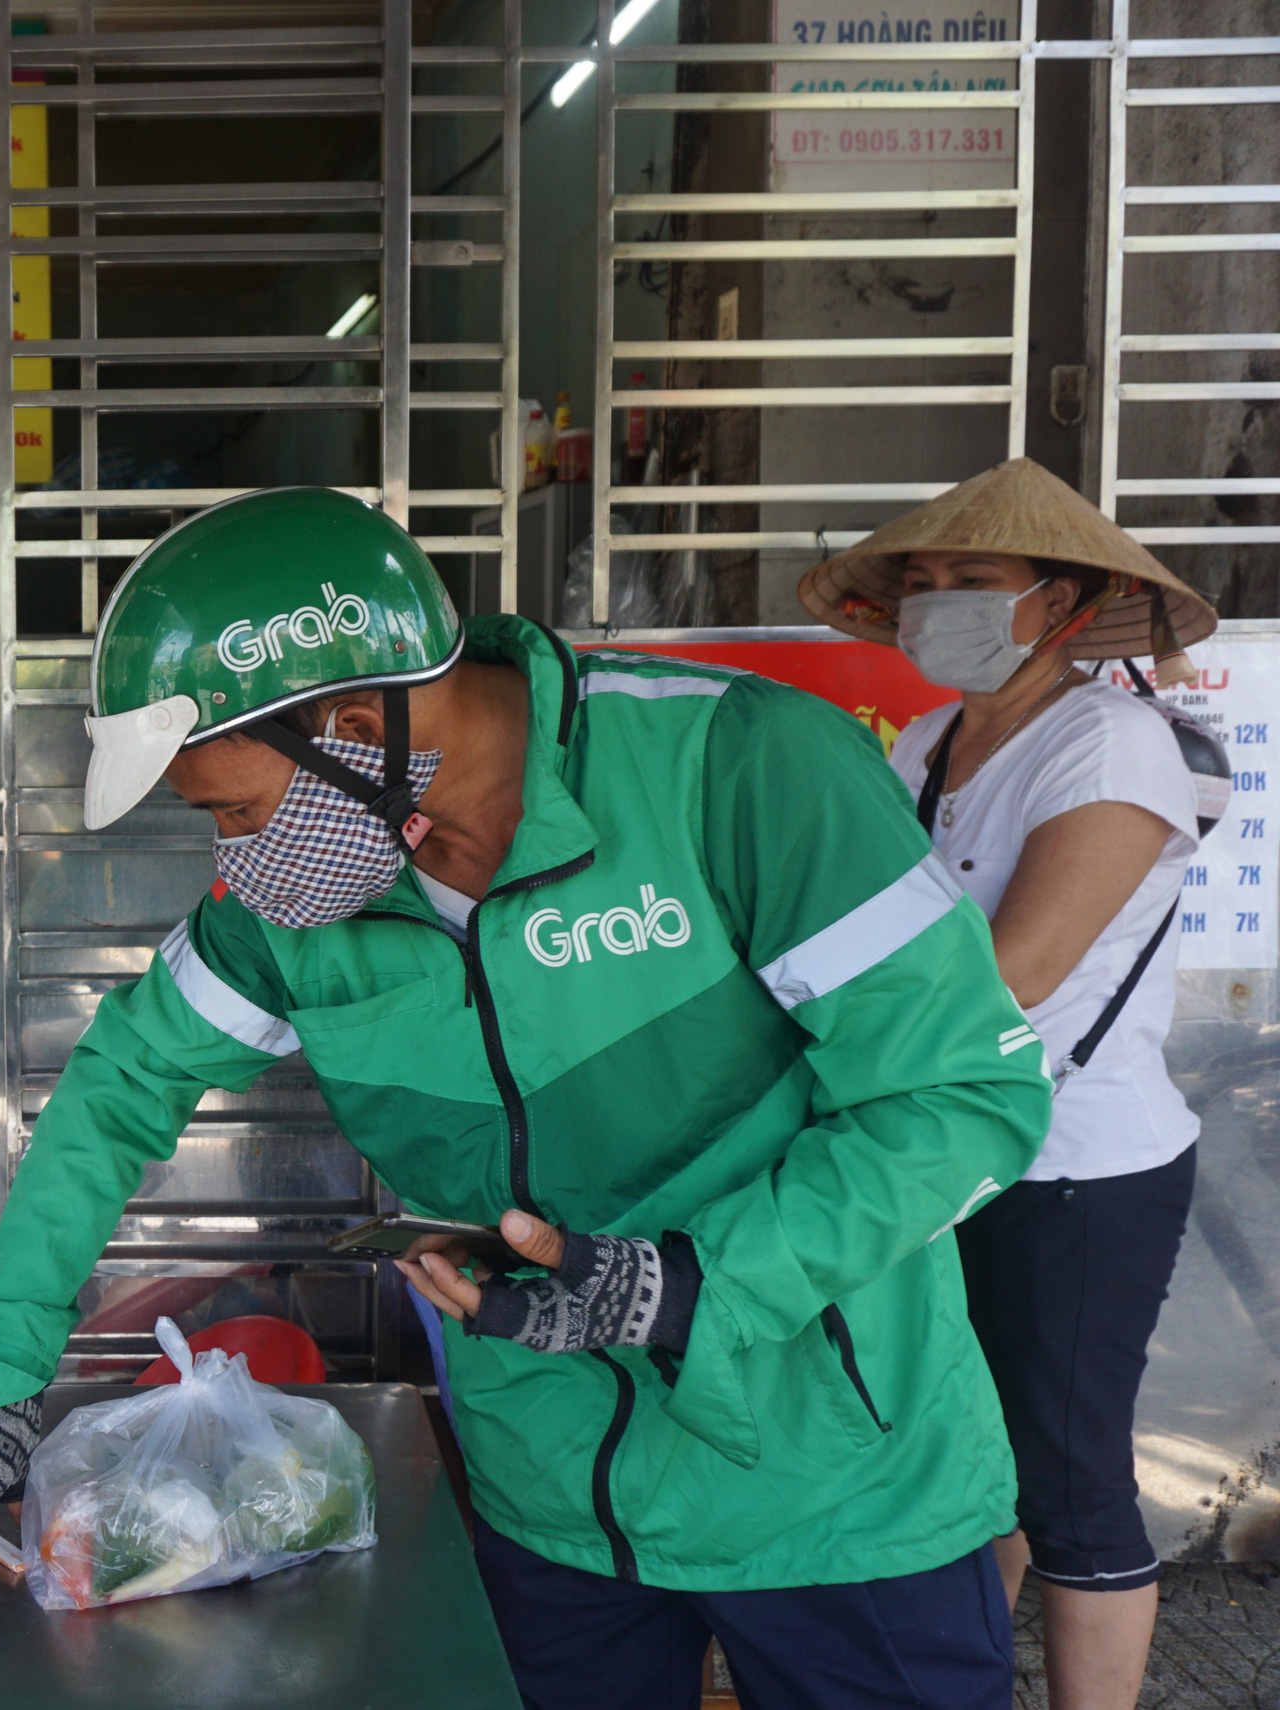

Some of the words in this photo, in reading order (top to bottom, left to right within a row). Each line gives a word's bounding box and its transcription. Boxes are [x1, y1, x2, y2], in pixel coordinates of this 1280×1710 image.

[793, 21, 826, 43] 37
[837, 12, 932, 43] HOÀNG
[792, 129, 830, 152] ĐT:
[839, 127, 1004, 152] 0905.317.331
[217, 581, 370, 673] Grab
[1234, 723, 1268, 744] 12K
[1232, 771, 1266, 791] 10K
[1240, 818, 1265, 838] 7K
[1183, 866, 1208, 886] NH
[1238, 865, 1261, 885] 7K
[524, 883, 691, 968] Grab
[1181, 912, 1206, 933] NH
[1235, 912, 1260, 932] 7K
